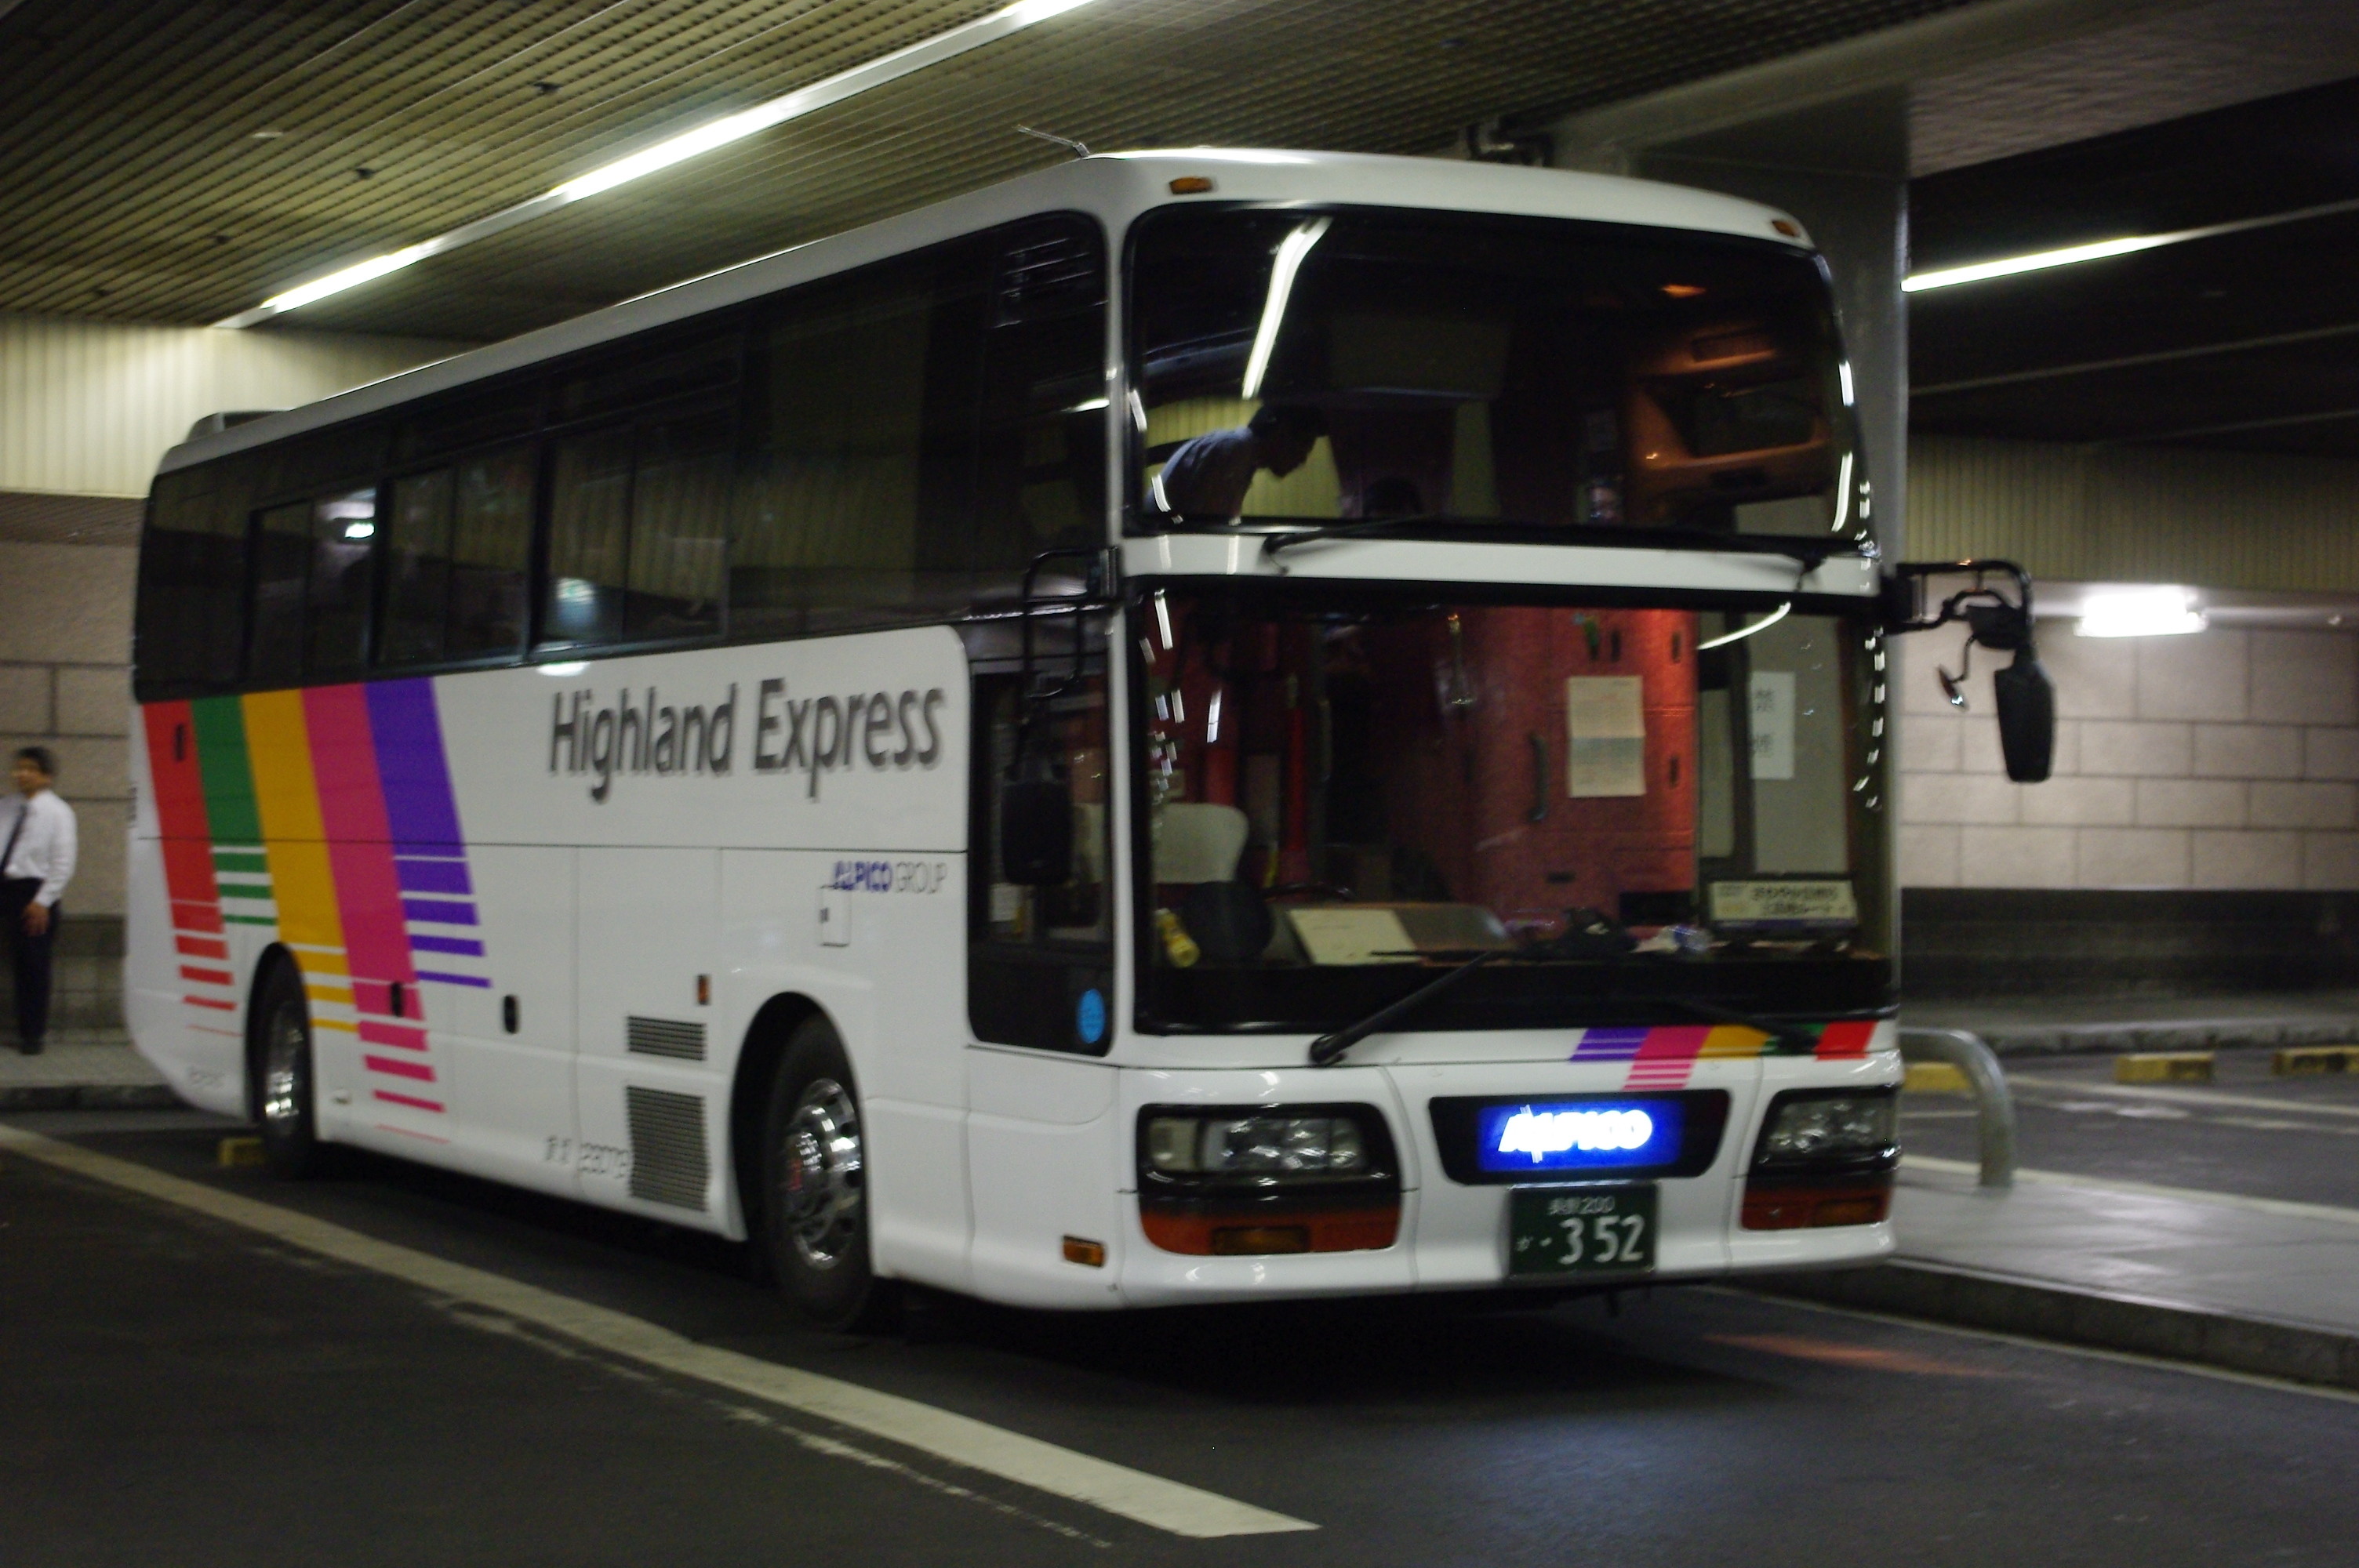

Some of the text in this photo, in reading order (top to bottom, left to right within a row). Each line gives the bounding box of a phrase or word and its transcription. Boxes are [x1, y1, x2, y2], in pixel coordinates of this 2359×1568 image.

[549, 677, 945, 804] Highland Express
[895, 862, 948, 894] GROUP
